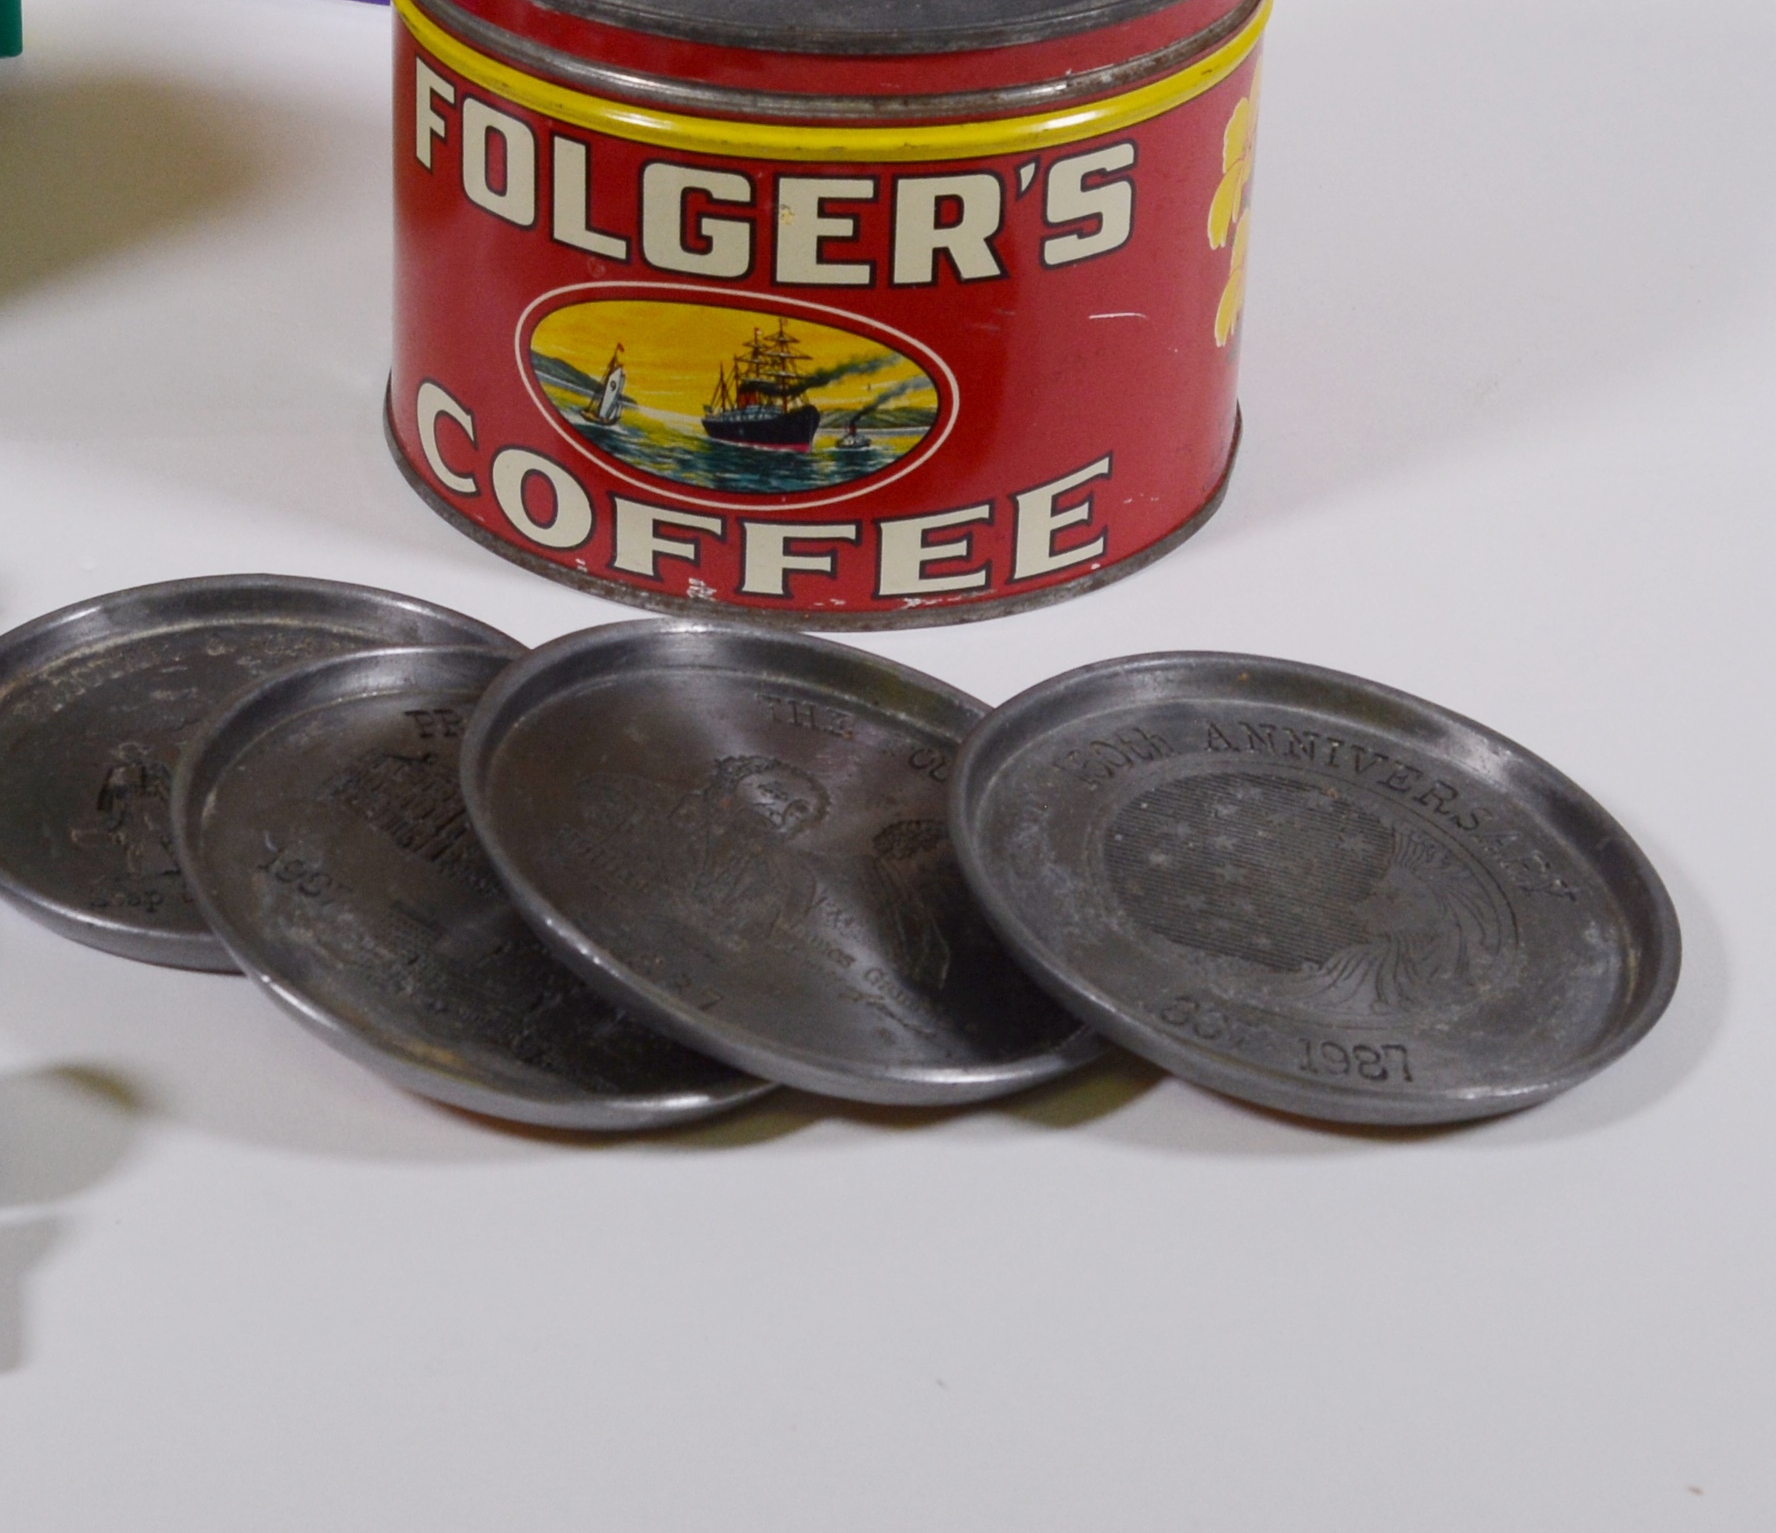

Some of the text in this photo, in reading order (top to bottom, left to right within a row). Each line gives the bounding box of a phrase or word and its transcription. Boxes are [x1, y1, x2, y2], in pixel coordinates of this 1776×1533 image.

[413, 53, 1138, 288] FOLGER'S
[414, 378, 1114, 599] COFFEE
[1203, 720, 1580, 906] ANNIVERSARY
[1295, 1036, 1414, 1084] 1987
